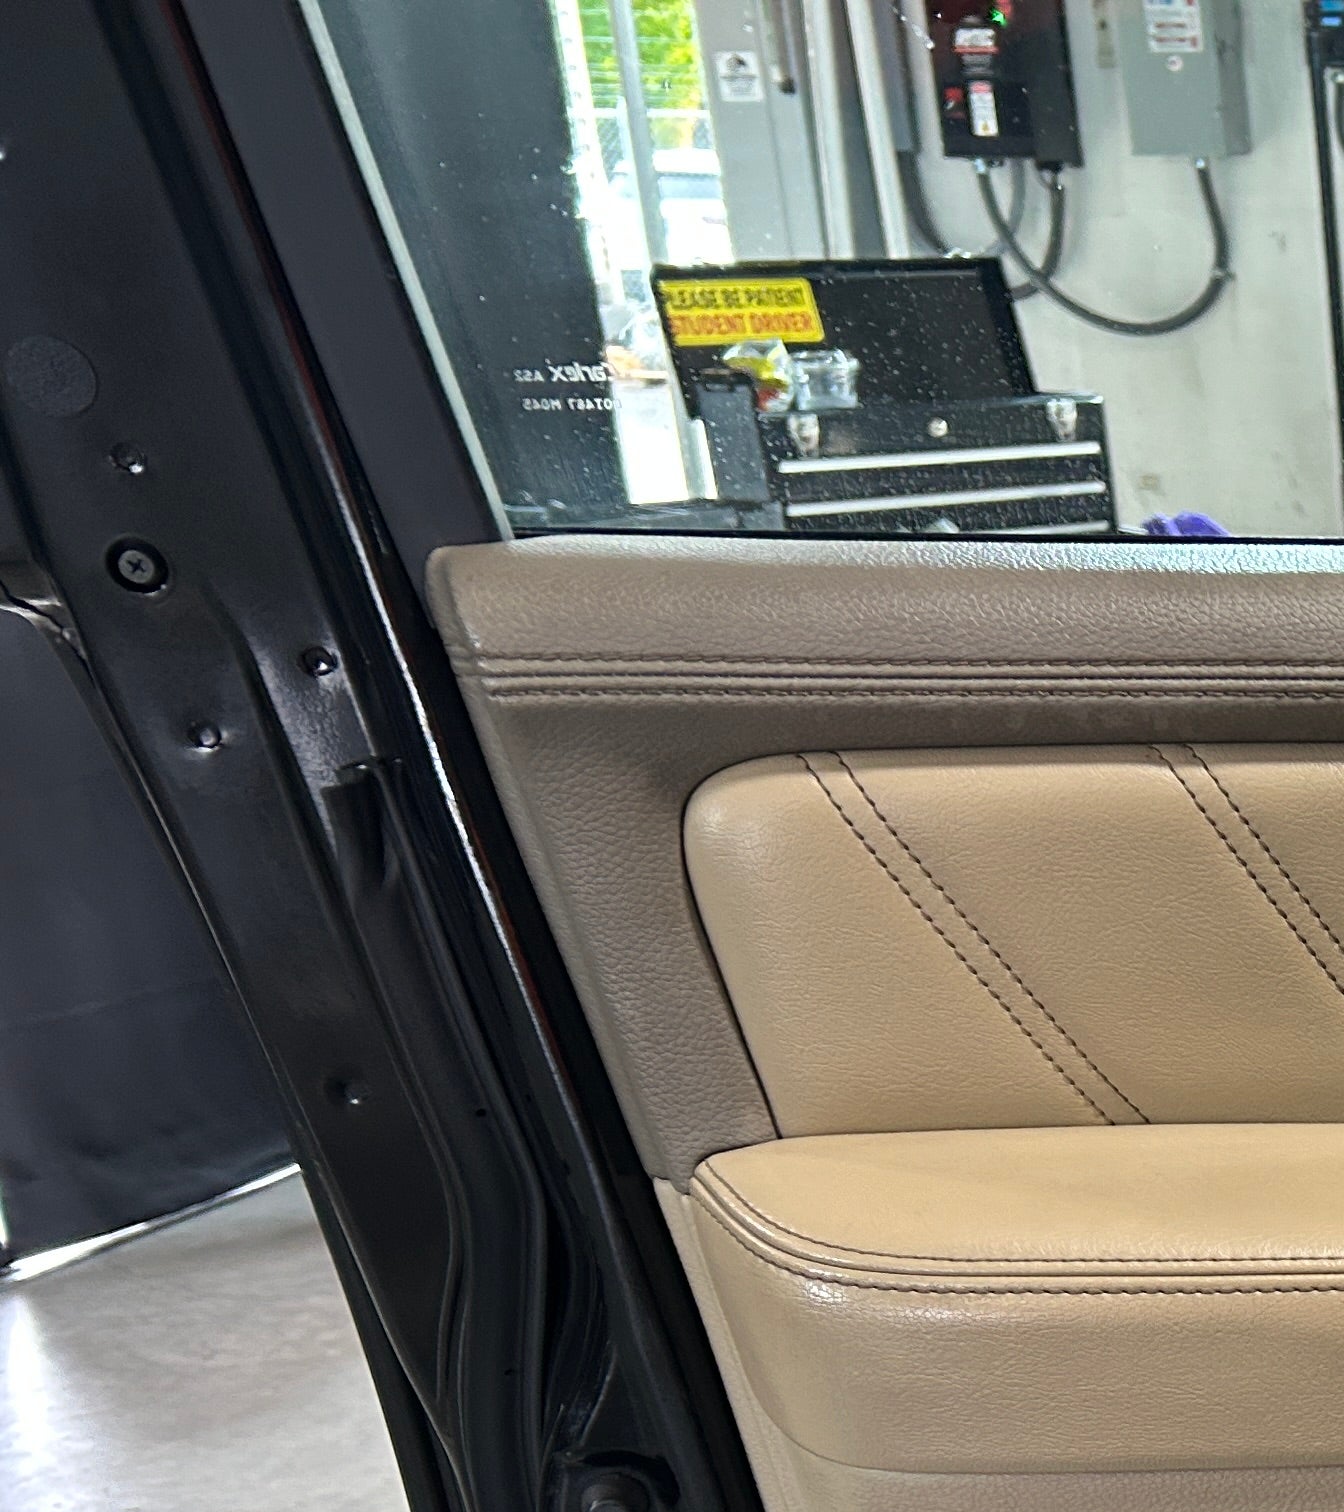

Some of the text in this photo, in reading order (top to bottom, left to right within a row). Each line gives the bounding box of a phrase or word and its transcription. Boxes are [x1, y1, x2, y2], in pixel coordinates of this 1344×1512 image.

[720, 286, 743, 308] BE
[744, 286, 805, 308] PATIENT
[668, 311, 814, 336] STUDENT DRIVER
